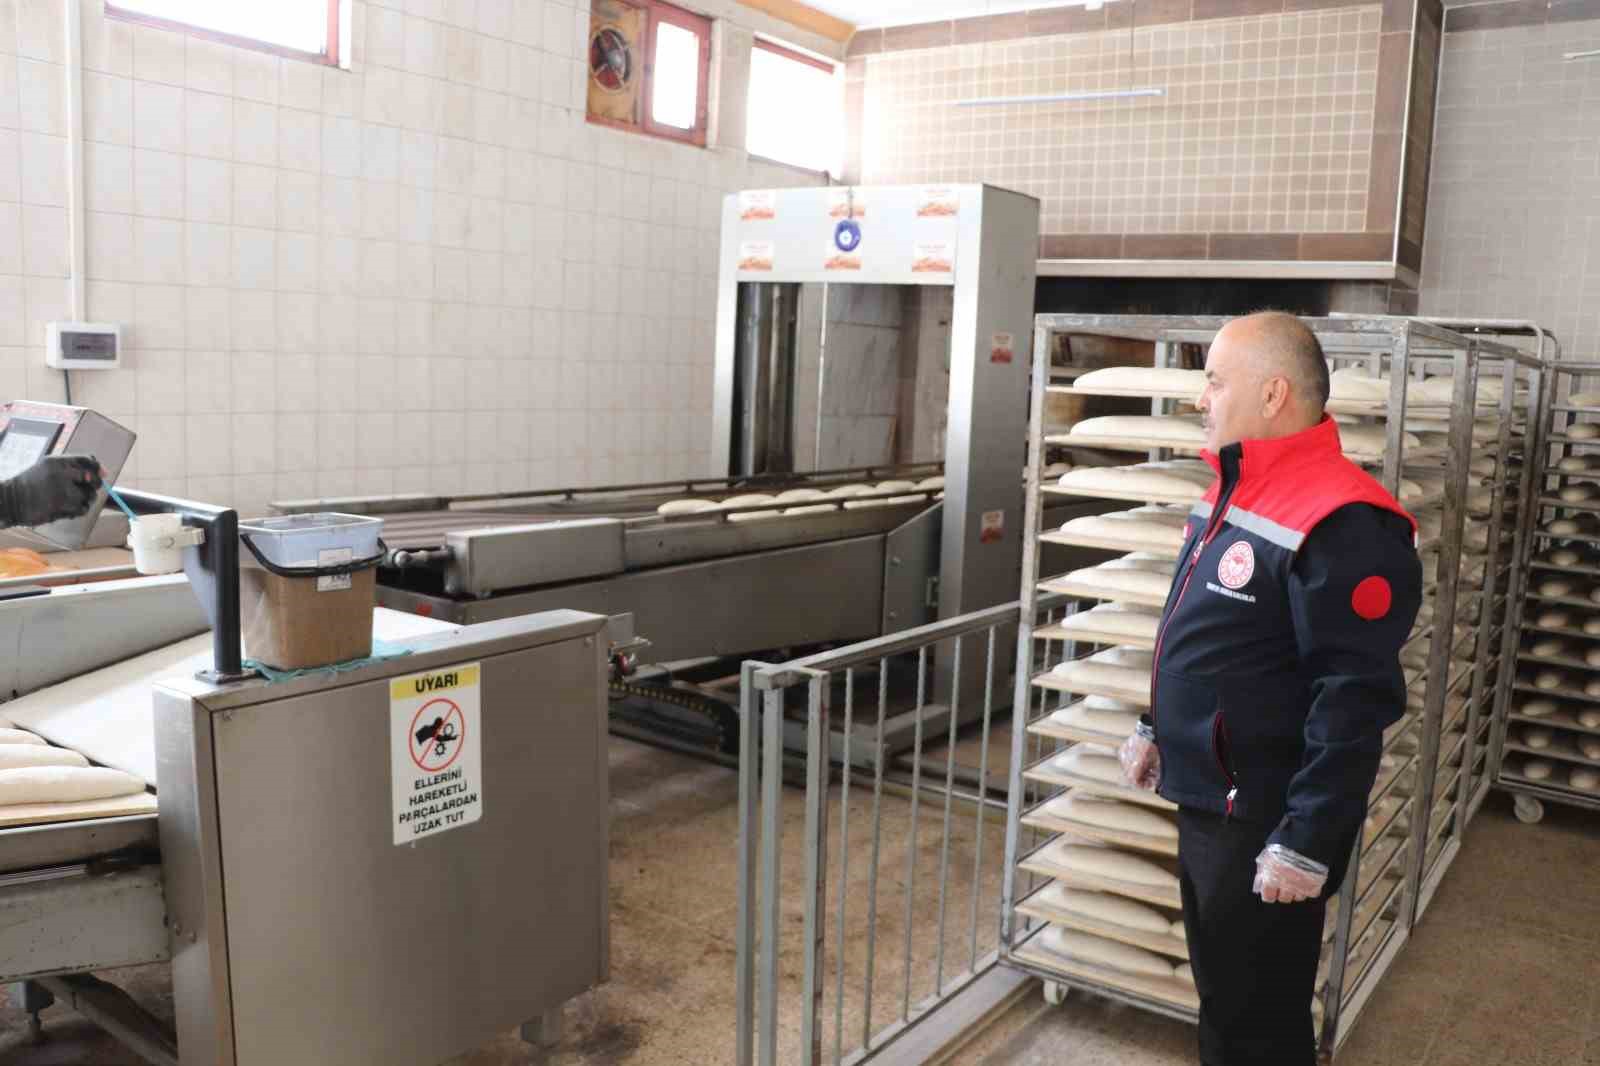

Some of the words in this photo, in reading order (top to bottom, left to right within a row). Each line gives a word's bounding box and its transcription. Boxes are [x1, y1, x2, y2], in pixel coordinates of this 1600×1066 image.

[415, 672, 458, 693] UYARI
[409, 779, 467, 806] HAREKETLİ
[399, 793, 477, 825] PARÇALARDAN
[414, 818, 442, 834] UZAK
[446, 811, 464, 823] TUT
